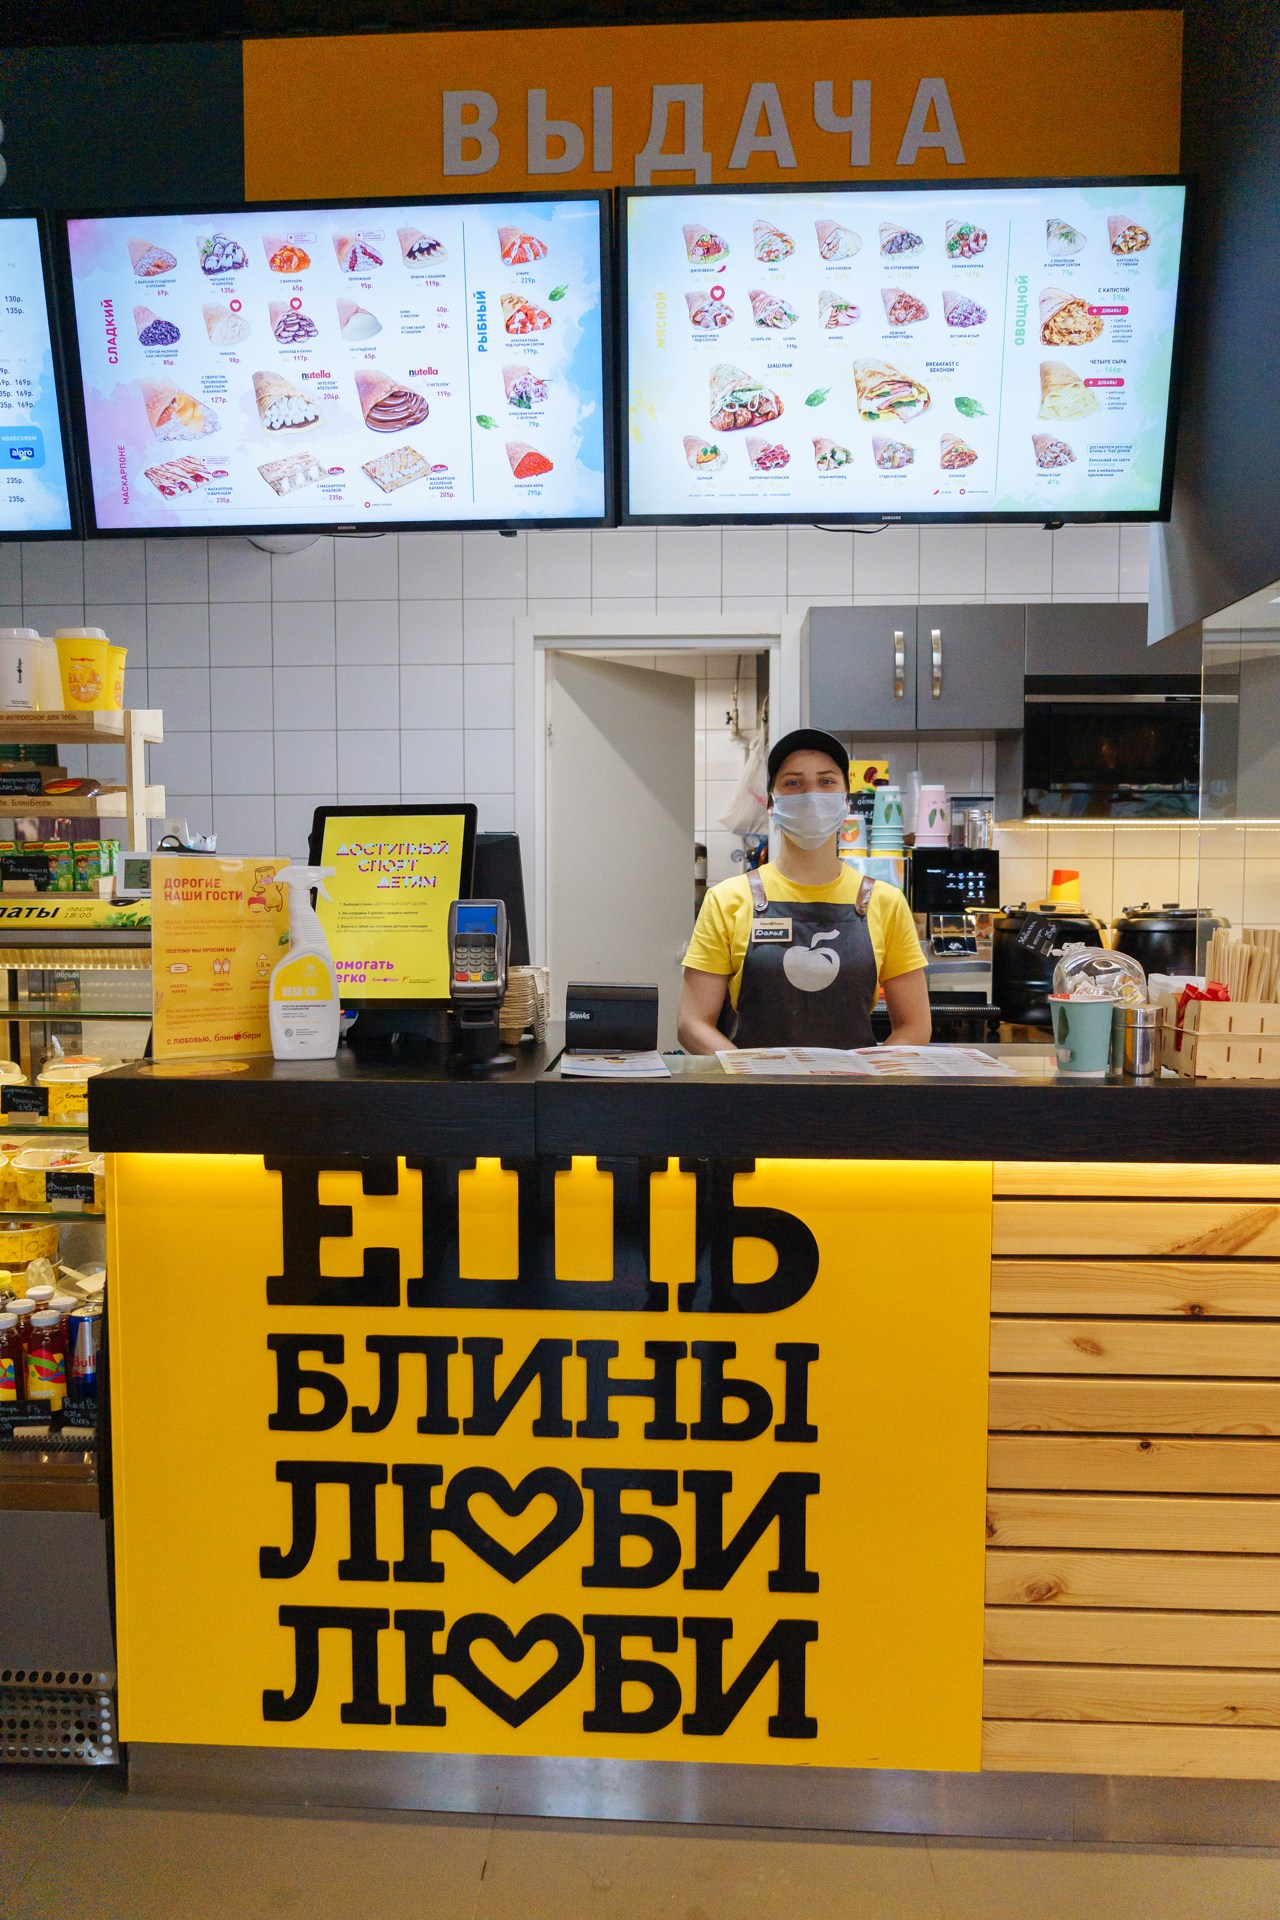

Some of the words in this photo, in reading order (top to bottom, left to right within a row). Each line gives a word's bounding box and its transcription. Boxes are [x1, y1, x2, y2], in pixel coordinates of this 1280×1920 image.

[443, 77, 967, 187] ВЫДАЧА
[425, 280, 442, 288] 119р.
[5, 295, 23, 303] 130р.
[6, 306, 25, 315] 135р.
[1015, 275, 1029, 346] ОВОЩНОЙ
[473, 290, 488, 352] РЫБНЫЙ
[653, 291, 667, 349] МЯСНОЙ
[100, 298, 119, 365] СЛАДКИЙ
[301, 370, 331, 380] nutella
[408, 367, 438, 377] nutella
[15, 378, 33, 387] 169р.
[16, 389, 34, 398] 169р.
[17, 401, 36, 409] 169р.
[210, 396, 229, 404] 127р.
[11, 447, 33, 458] alpro
[117, 444, 130, 505] МАСКАРПОНЕ
[6, 477, 25, 485] 235р.
[8, 495, 27, 504] 235р.
[336, 840, 449, 856] ДОСТУПНЫЙ
[358, 859, 419, 873] СПОРТ
[164, 877, 221, 890] ДОРОГИЕ
[376, 876, 437, 888] ДЕТЯМ
[164, 890, 204, 902] НАШИ
[205, 889, 244, 902] ГОСТИ
[333, 961, 395, 970] омогать
[335, 974, 368, 983] егко
[172, 1035, 212, 1044] ЛЮБОВЬЮ,
[263, 1155, 820, 1313] ЕШЬ
[266, 1333, 820, 1443] БЛИНЫ
[64, 1397, 85, 1410] Red
[259, 1460, 821, 1594] ЛЮБИ
[262, 1604, 820, 1739] ЛЮБИ
